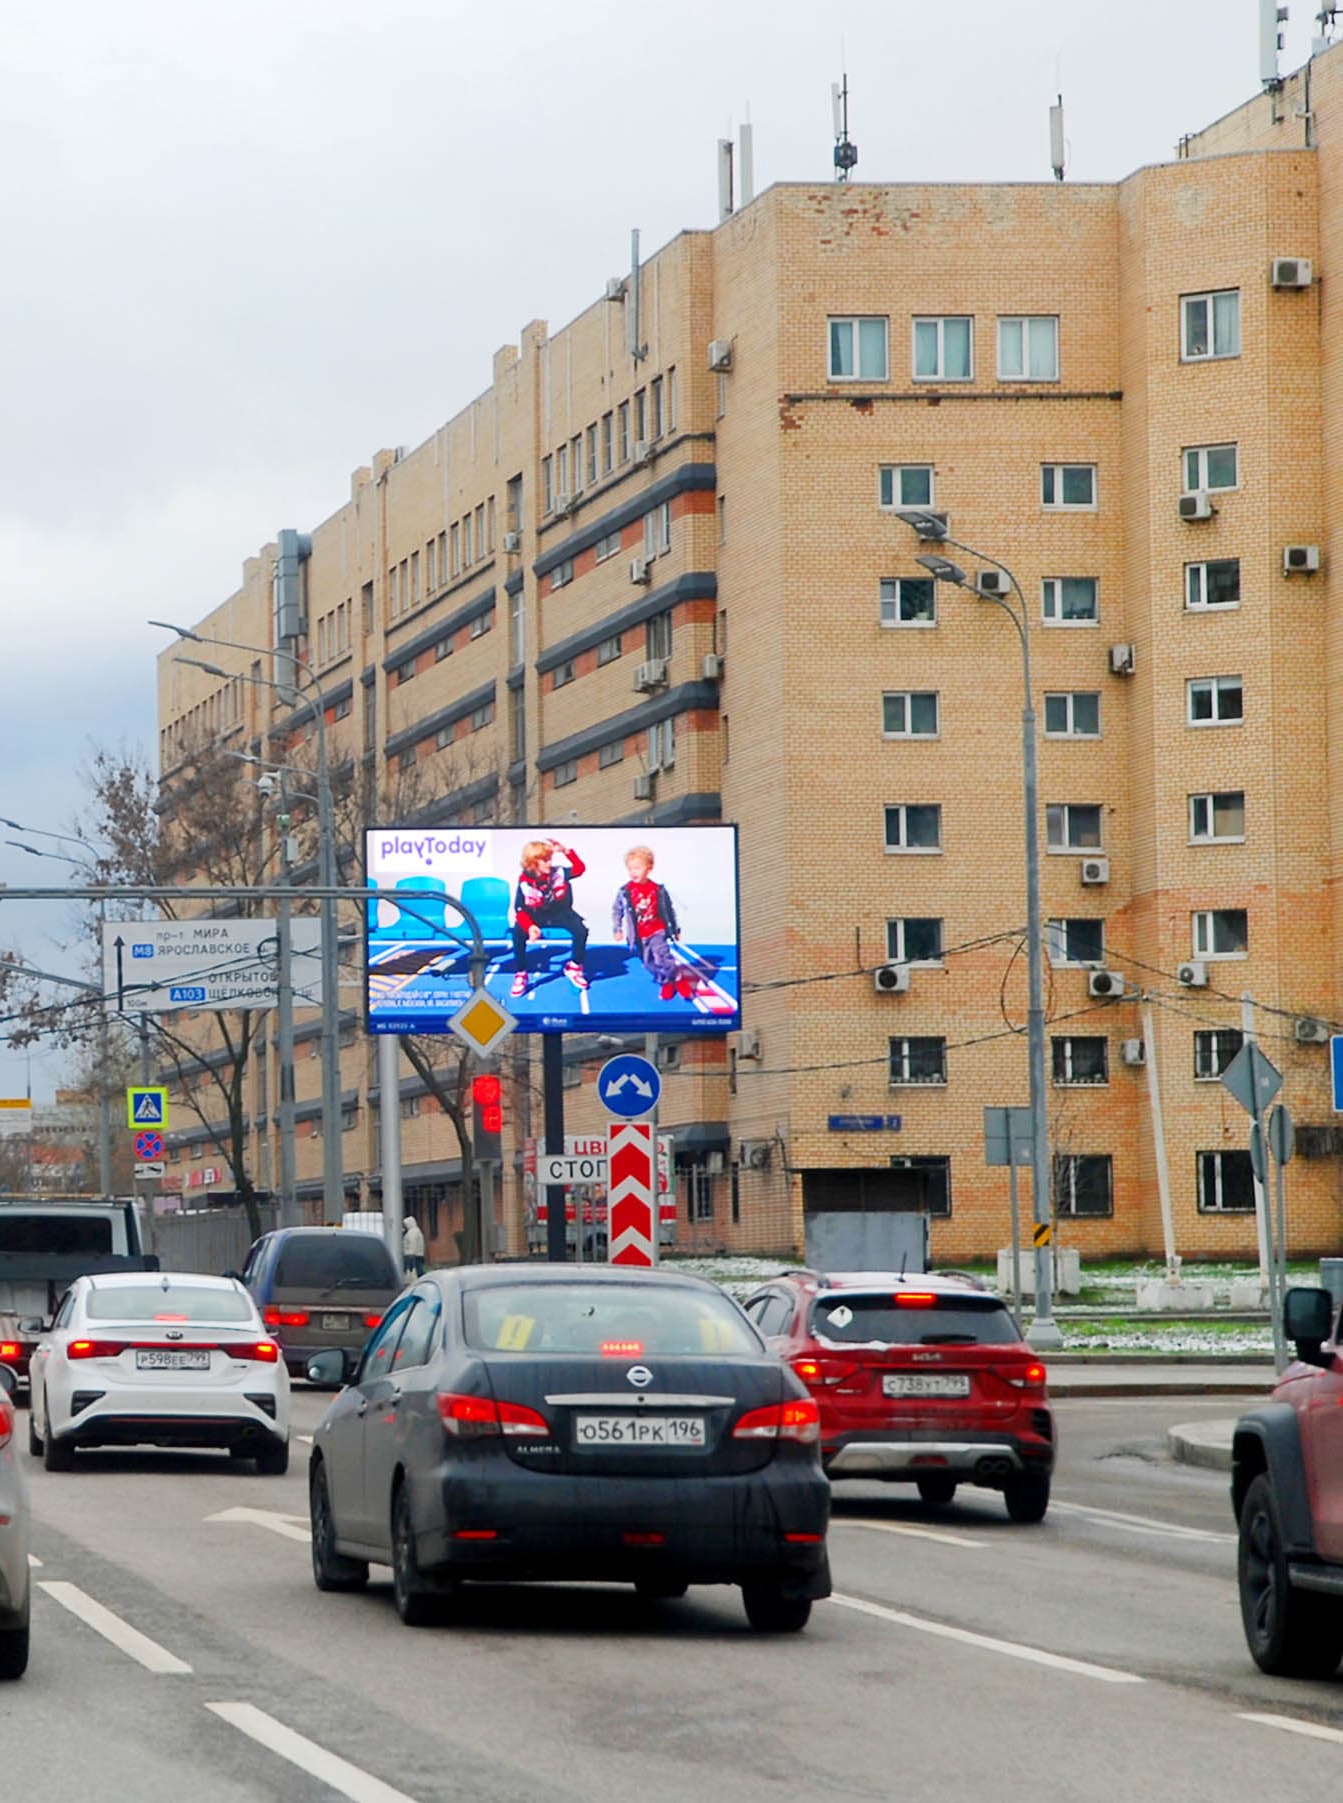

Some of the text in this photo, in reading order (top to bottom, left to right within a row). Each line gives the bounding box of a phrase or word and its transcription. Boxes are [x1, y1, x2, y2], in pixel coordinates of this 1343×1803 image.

[381, 835, 486, 859] playToday
[156, 928, 230, 942] пр-т МИРА
[157, 943, 250, 956] ЯРОСЛАВСКОЕ
[574, 1140, 608, 1155] ЦВ
